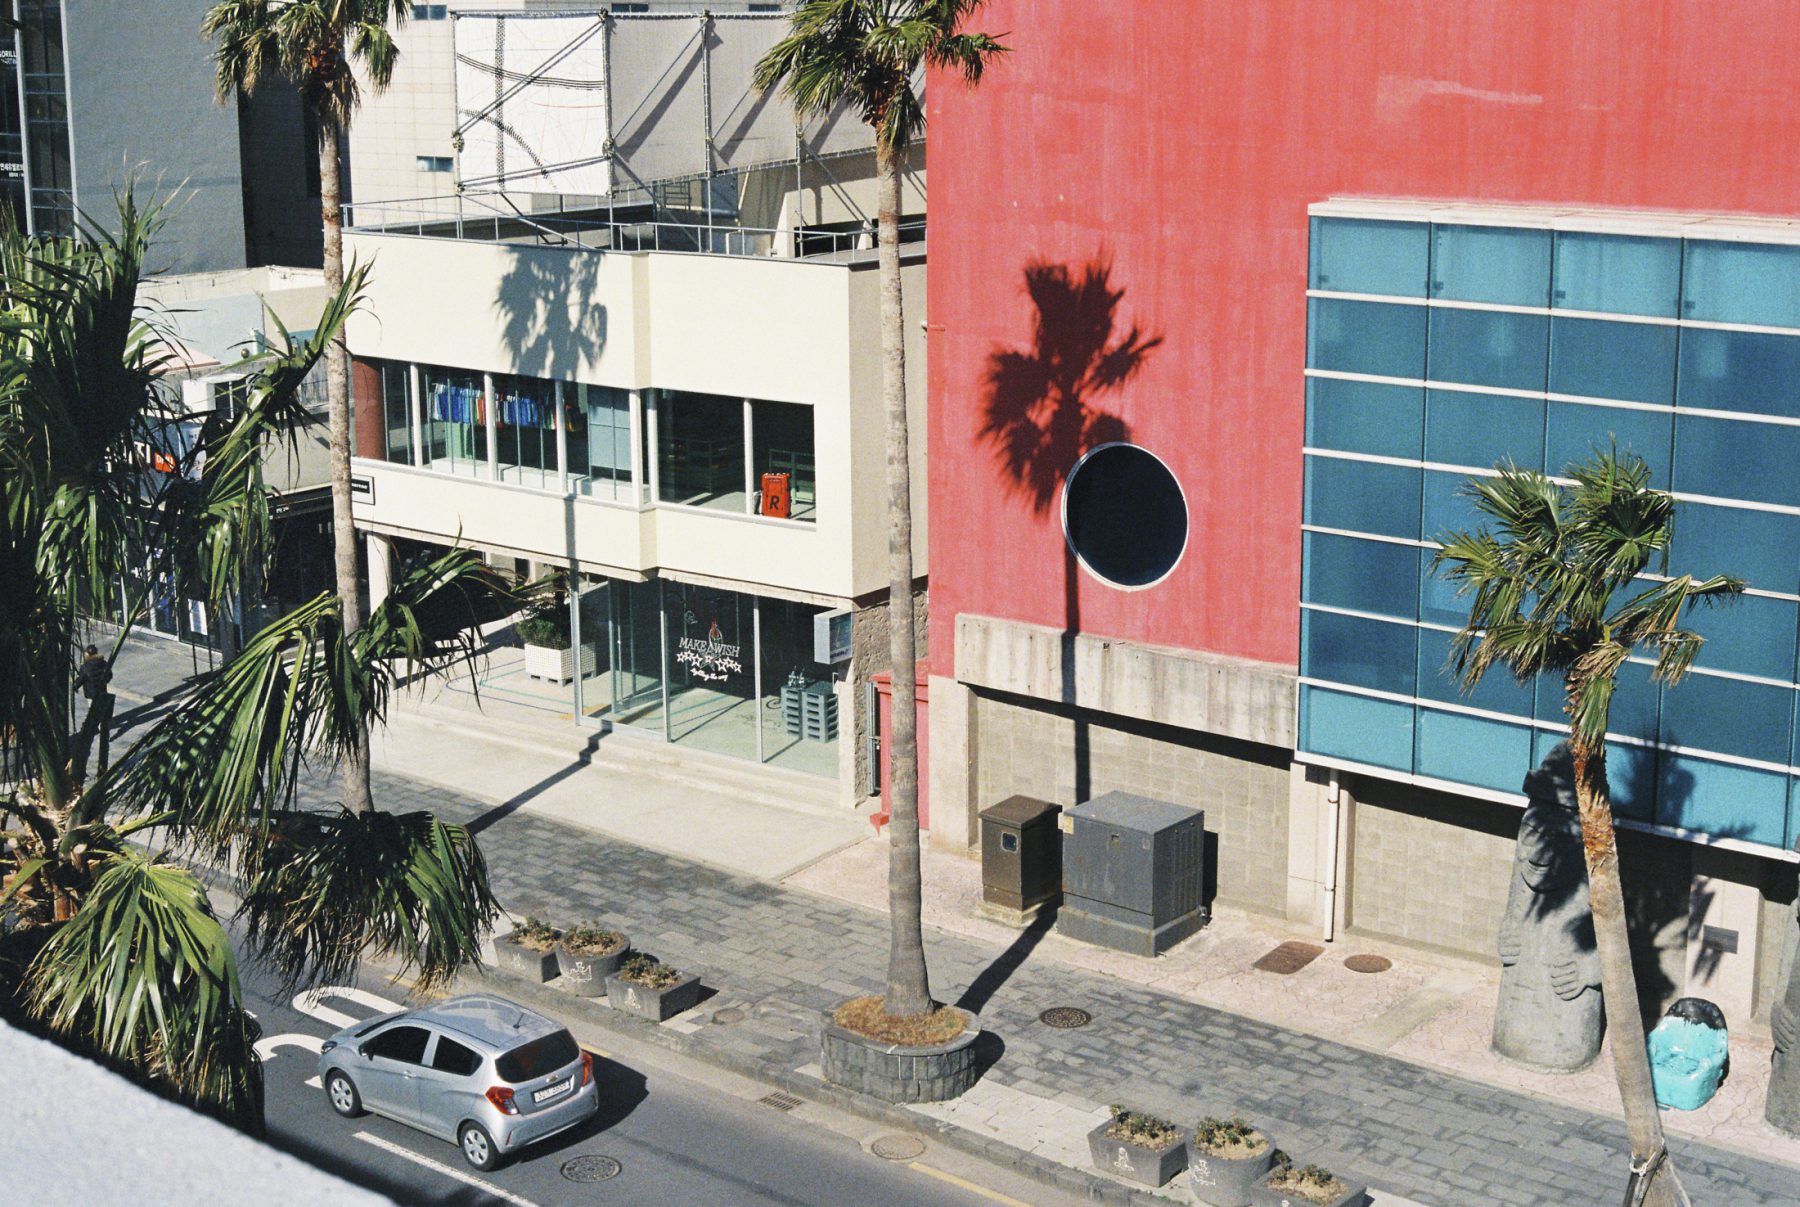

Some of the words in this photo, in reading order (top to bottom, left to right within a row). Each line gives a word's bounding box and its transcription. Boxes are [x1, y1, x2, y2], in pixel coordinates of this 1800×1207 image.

[769, 495, 780, 510] R
[679, 636, 707, 651] MAKE
[714, 643, 740, 658] WISH
